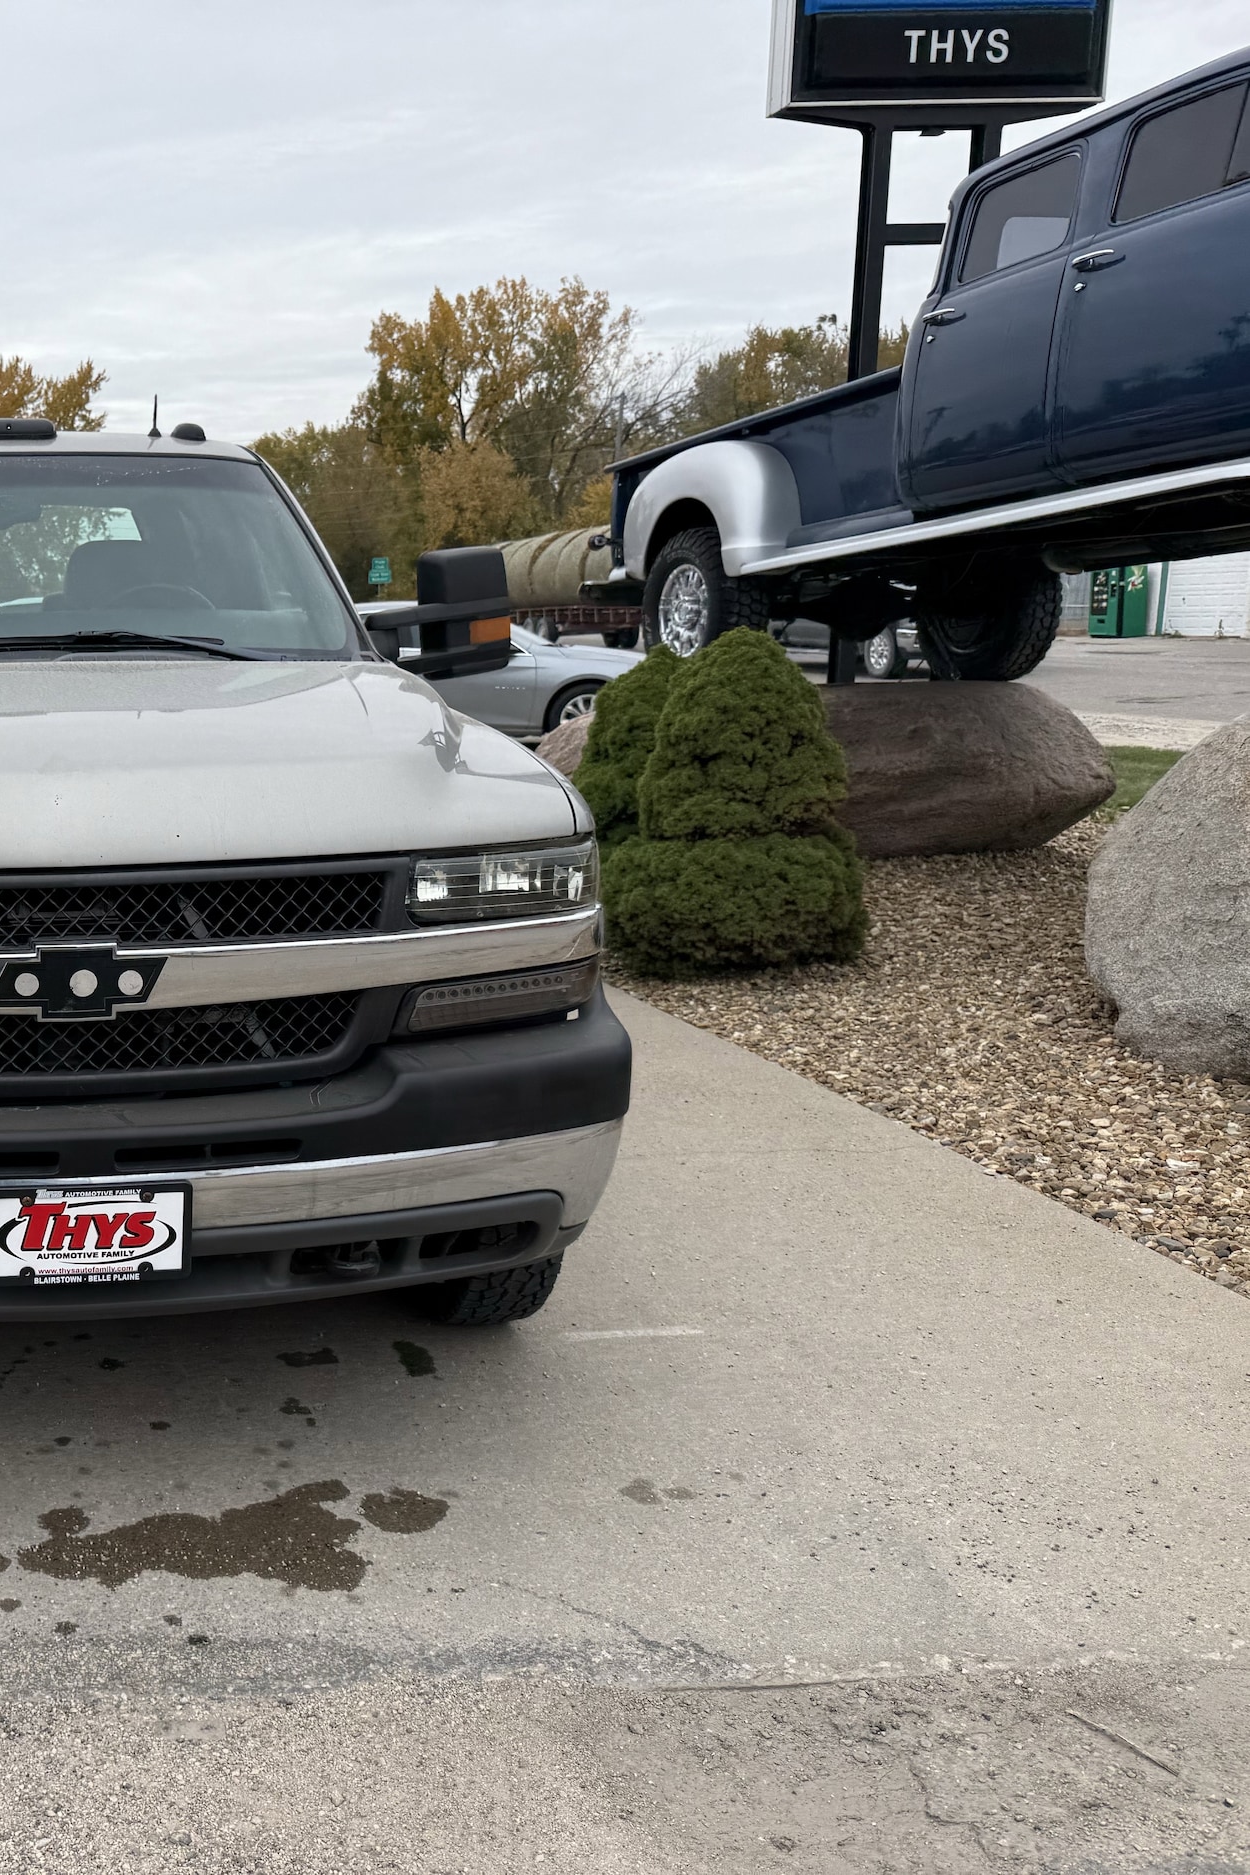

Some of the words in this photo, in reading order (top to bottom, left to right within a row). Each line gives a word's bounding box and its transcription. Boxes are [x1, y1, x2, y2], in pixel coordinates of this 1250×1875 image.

[904, 28, 1009, 63] THYS
[64, 1190, 114, 1198] AUTOMOTIVE
[18, 1202, 157, 1251] THYS
[36, 1251, 99, 1260] AUTOMOTIVE
[101, 1250, 136, 1258] FAMILY
[38, 1266, 134, 1274] www.thysautofamily.com
[34, 1276, 82, 1284] BLAIRSTOWN
[88, 1274, 111, 1283] BELLE
[112, 1273, 140, 1282] PLAINE
